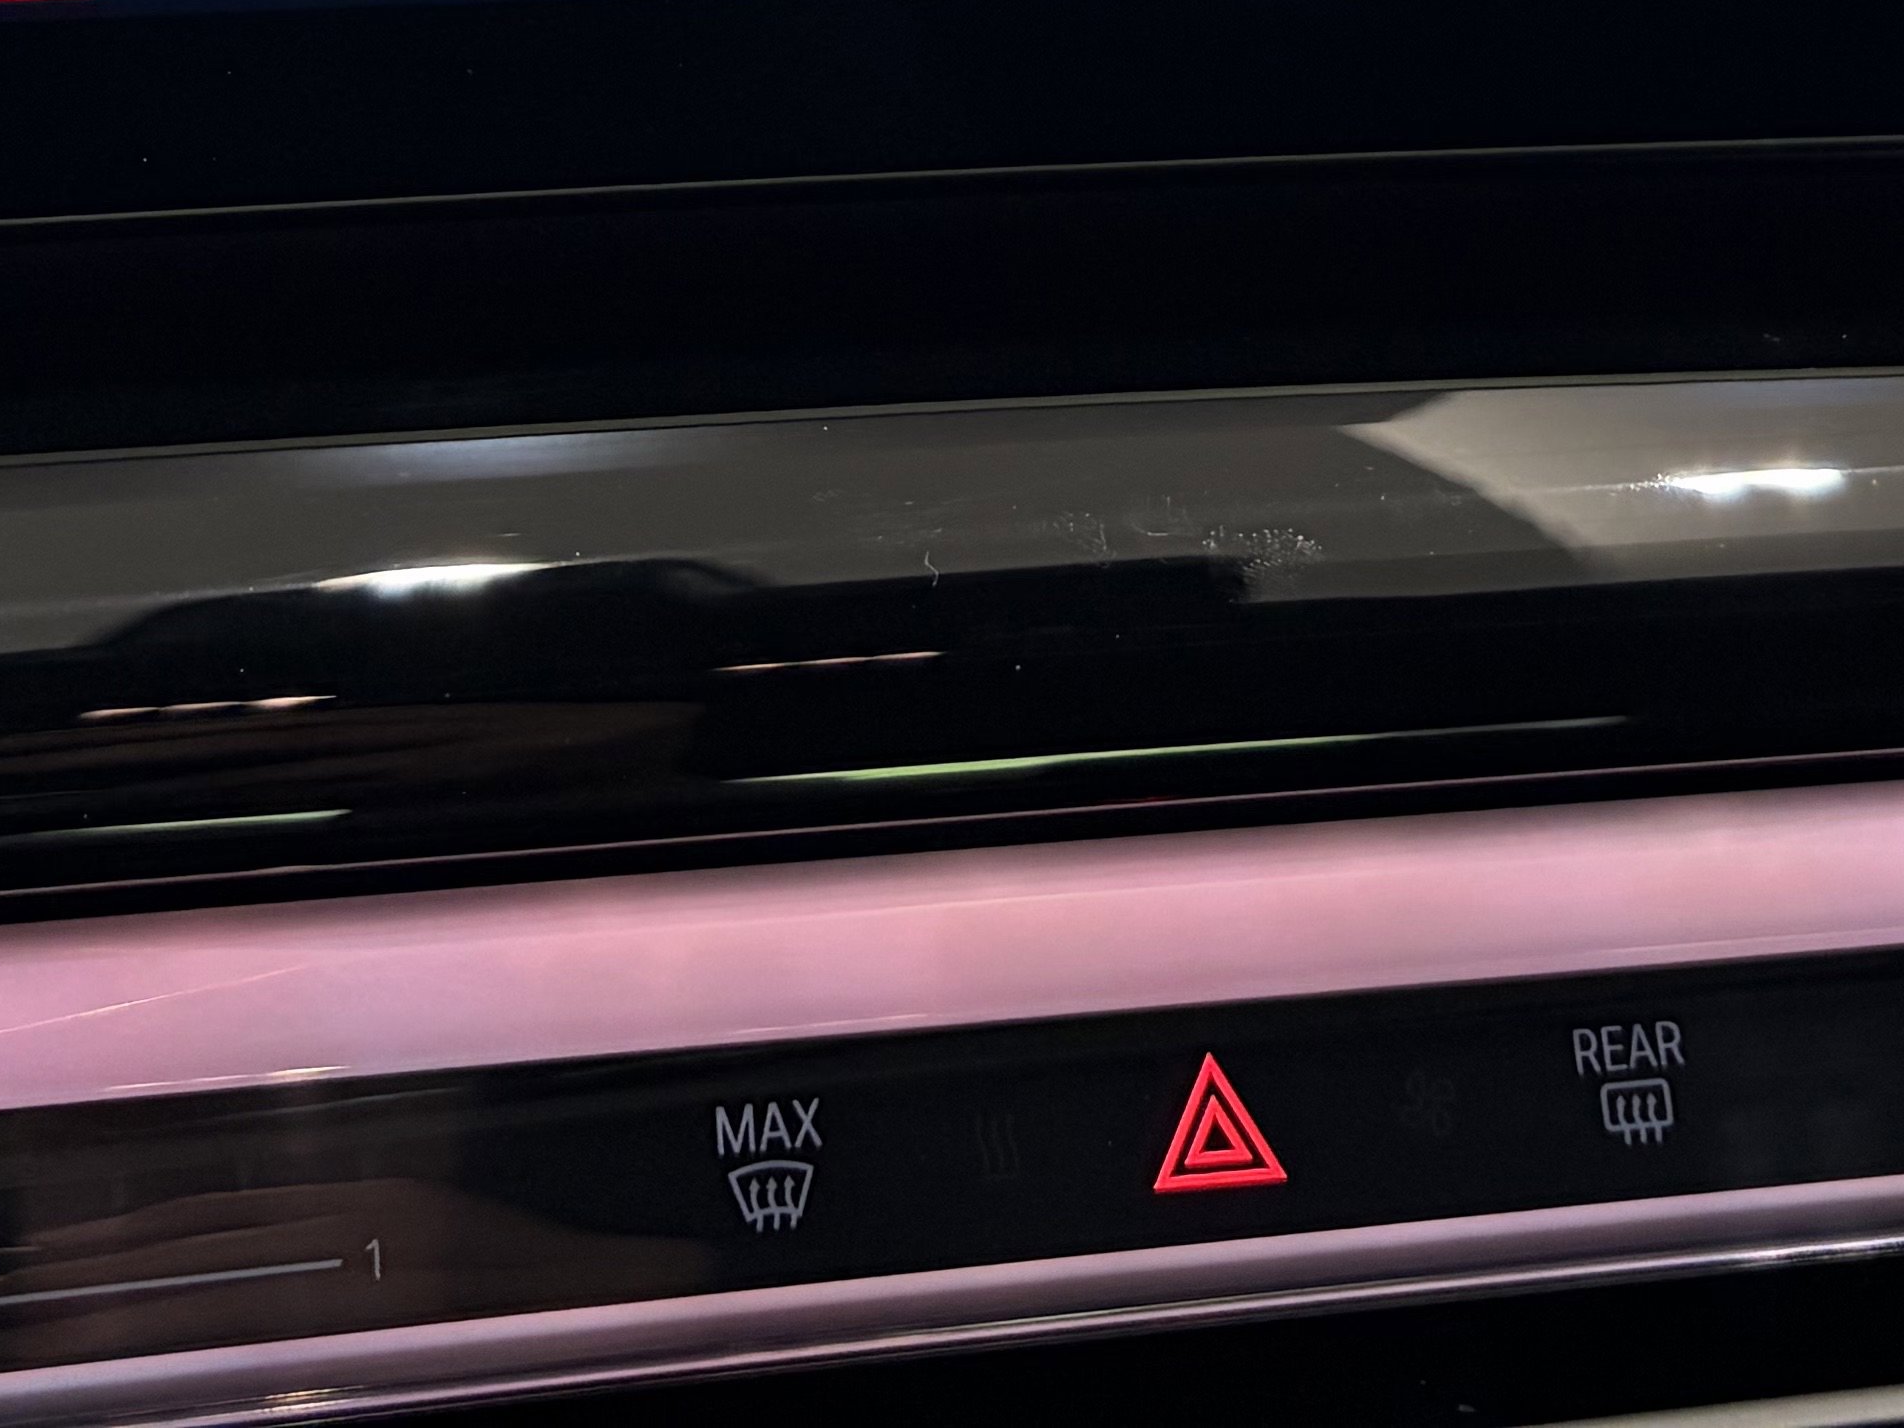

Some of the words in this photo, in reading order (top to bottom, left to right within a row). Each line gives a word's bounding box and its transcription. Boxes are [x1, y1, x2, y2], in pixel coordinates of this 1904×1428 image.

[1571, 1019, 1686, 1078] REAR
[714, 1096, 824, 1158] MAX
[364, 1237, 382, 1282] 1
